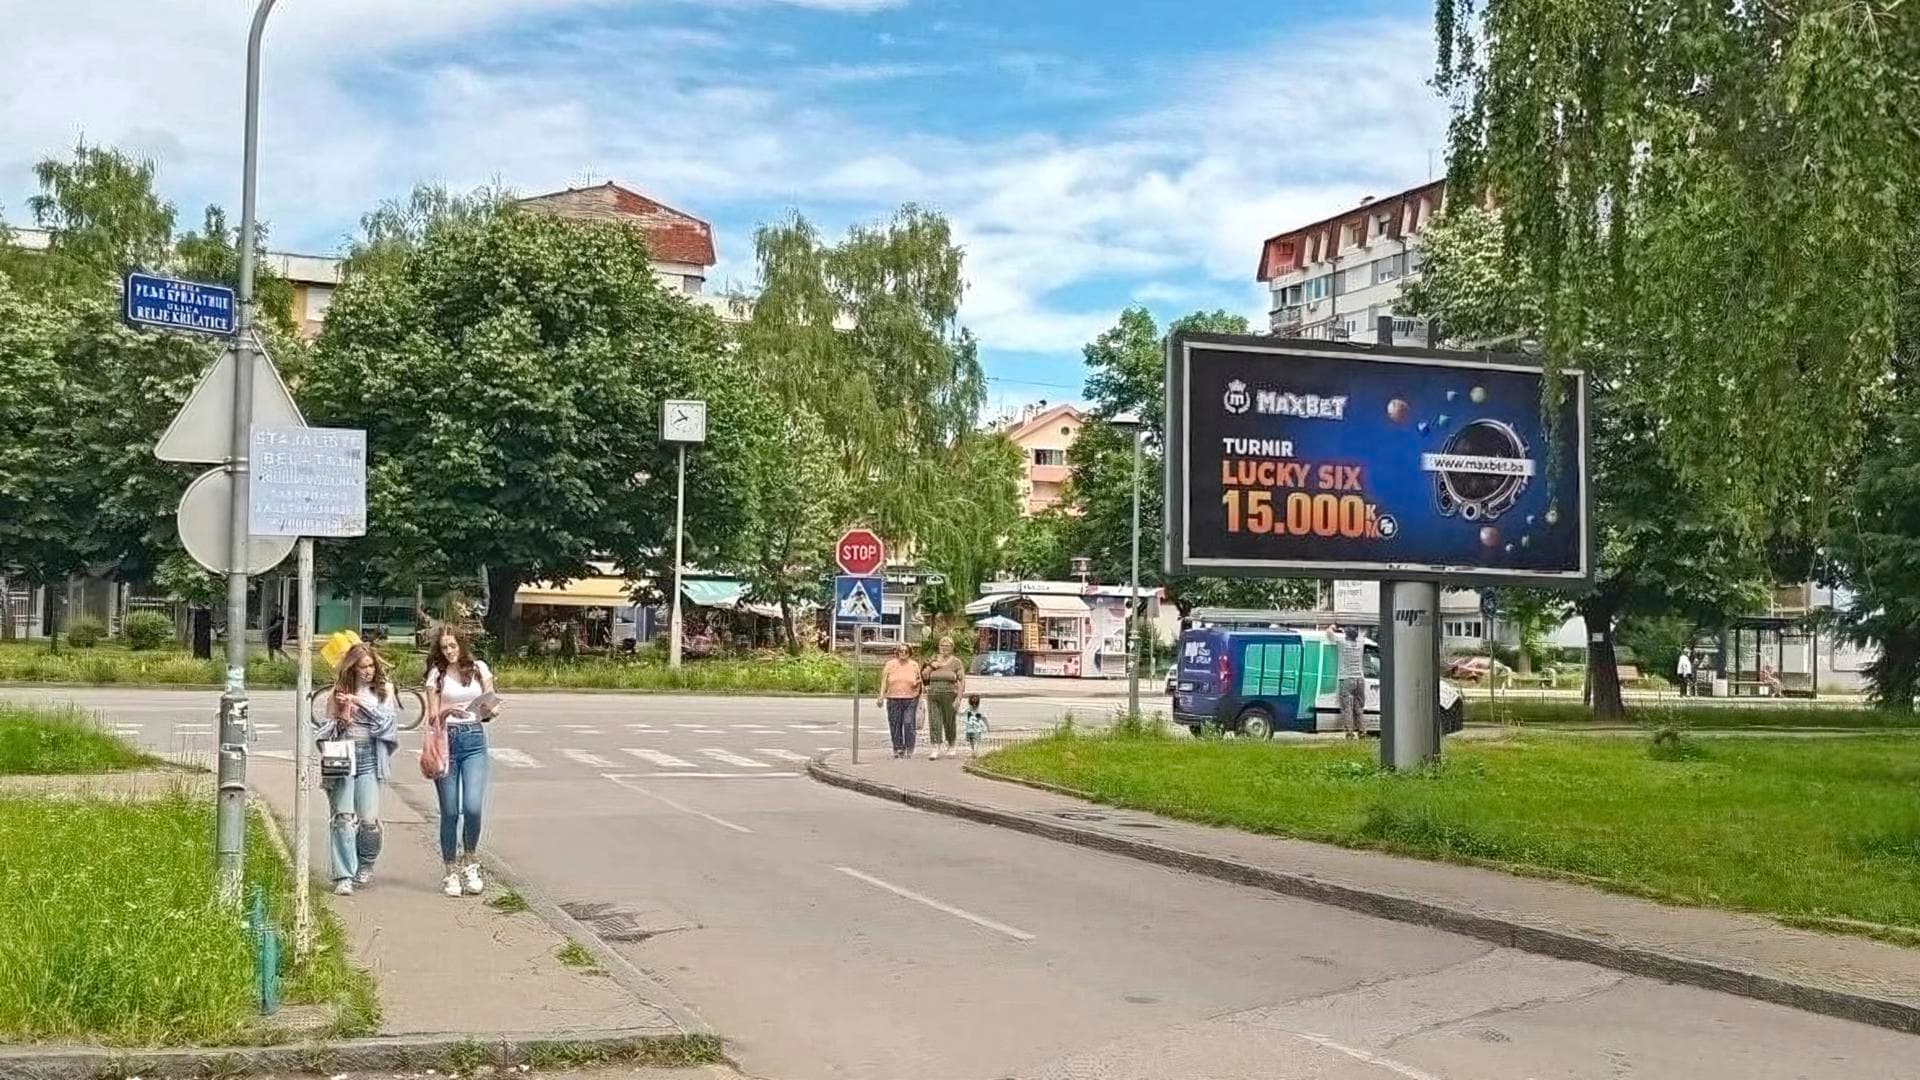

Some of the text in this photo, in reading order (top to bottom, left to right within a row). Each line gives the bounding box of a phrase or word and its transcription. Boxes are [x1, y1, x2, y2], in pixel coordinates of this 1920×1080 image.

[166, 303, 200, 314] ULICA
[172, 311, 228, 330] KRILATICE
[1222, 437, 1294, 457] TURNIR
[1434, 457, 1525, 473] www.maxbet.ba
[1222, 460, 1362, 490] LUCKY SIX
[1222, 489, 1365, 539] 15.000
[842, 544, 877, 560] STOP
